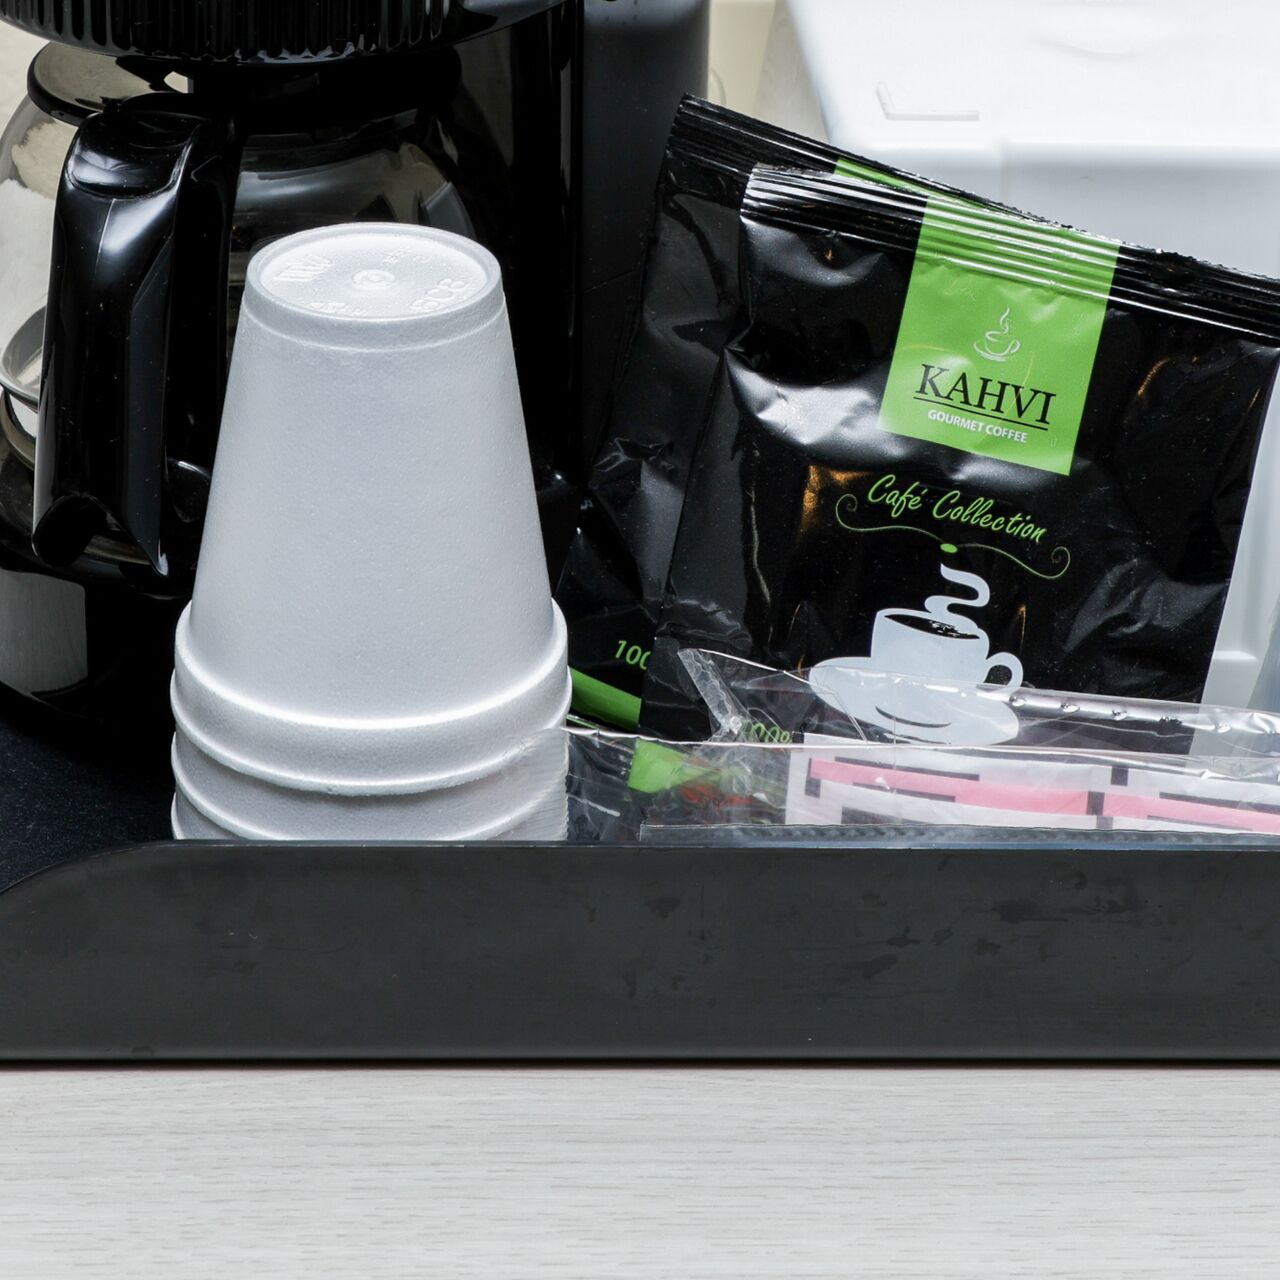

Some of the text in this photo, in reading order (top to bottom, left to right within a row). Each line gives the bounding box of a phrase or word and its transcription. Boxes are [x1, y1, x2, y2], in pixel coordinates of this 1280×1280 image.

[915, 363, 1056, 425] KAHVI
[927, 408, 1028, 443] GOURMET COFFEE
[868, 474, 1047, 544] Café Collection
